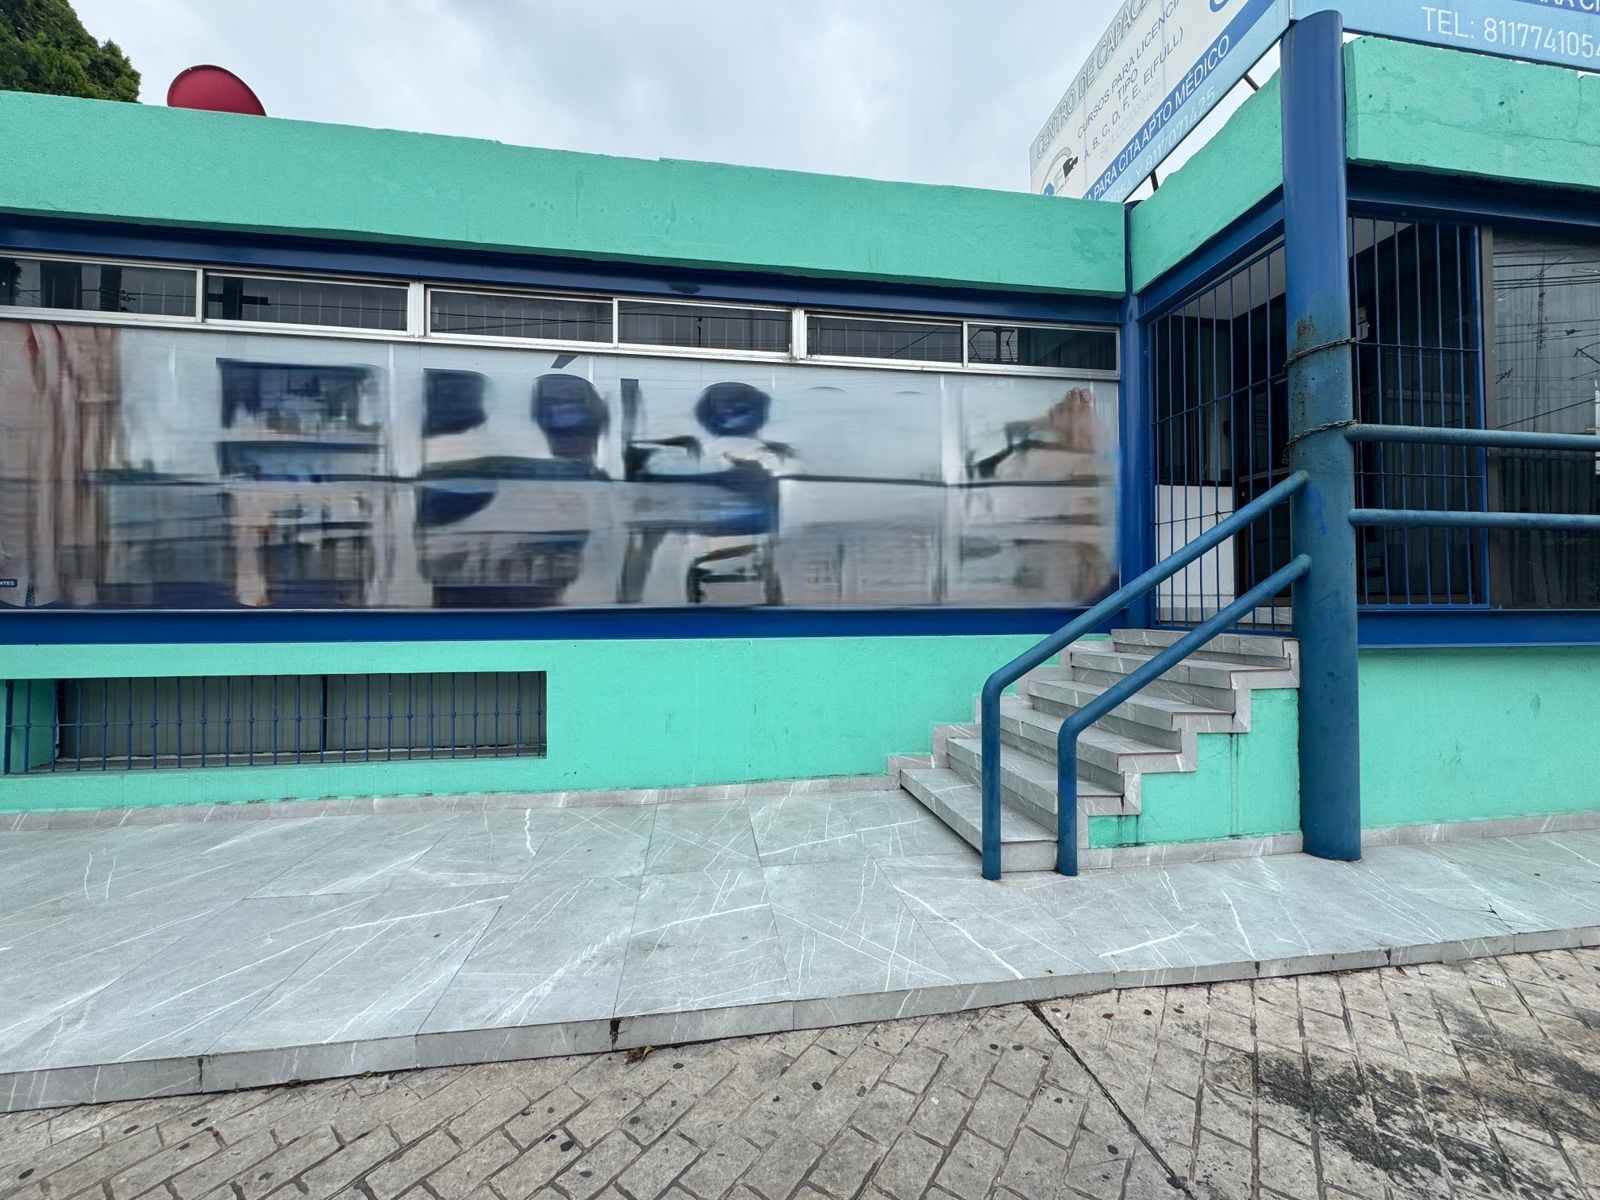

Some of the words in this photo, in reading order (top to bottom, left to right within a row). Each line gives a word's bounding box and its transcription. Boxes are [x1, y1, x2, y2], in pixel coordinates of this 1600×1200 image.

[1421, 6, 1474, 39] TEL:
[1037, 88, 1076, 159] CENTRO
[1078, 57, 1095, 101] DE
[1078, 89, 1110, 139] CURSOS
[1112, 57, 1135, 93] PARA
[1093, 166, 1118, 200] PARA
[1118, 139, 1141, 172] CITA
[1175, 34, 1230, 109] MÉDICO
[1117, 68, 1138, 100] TIPO
